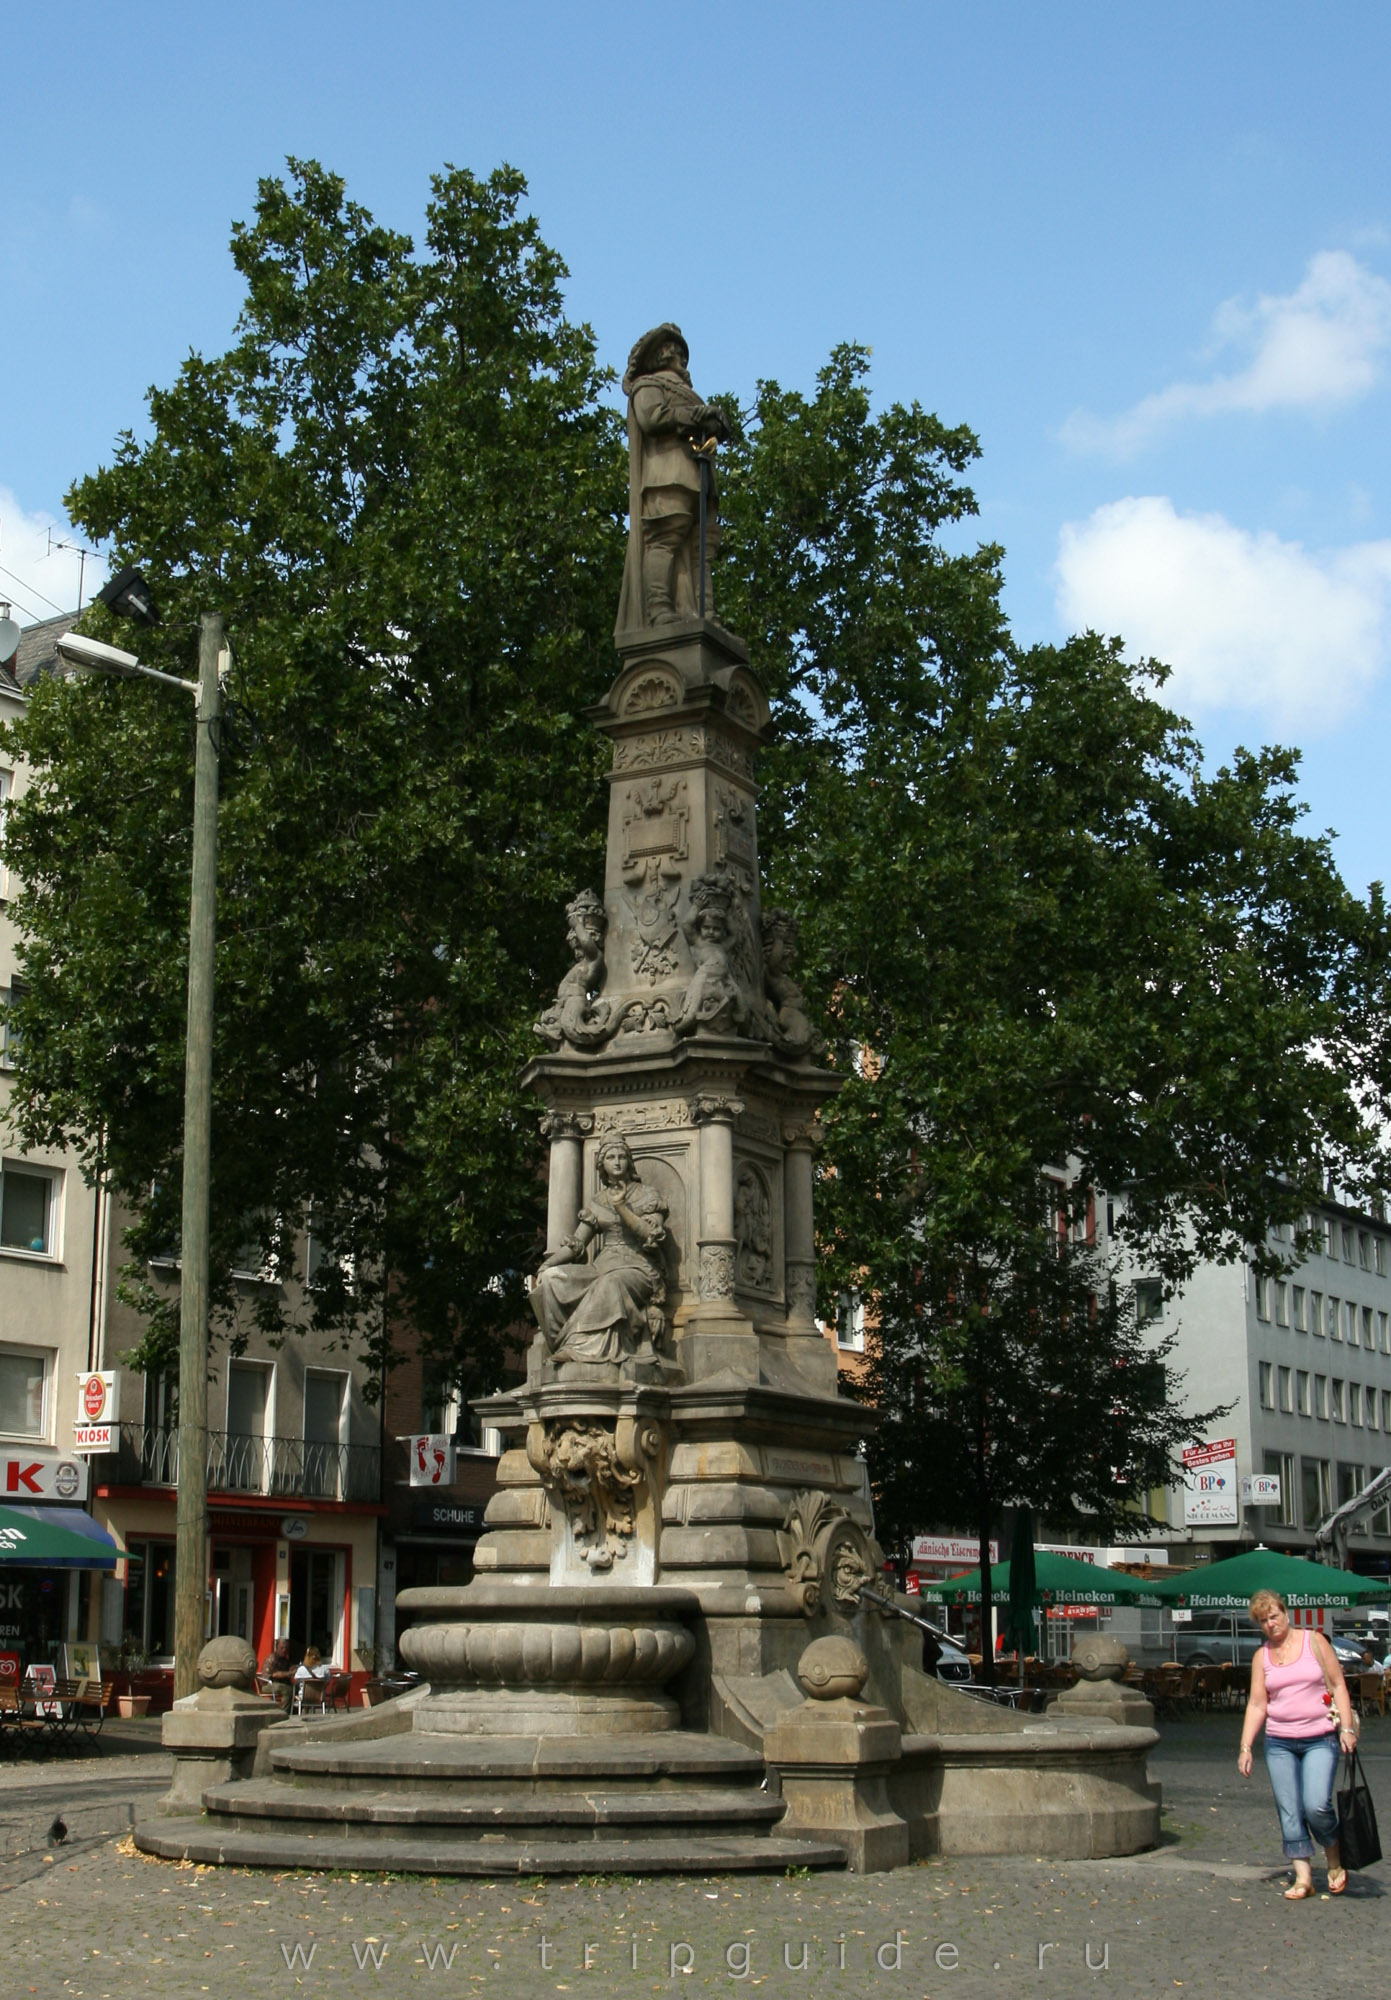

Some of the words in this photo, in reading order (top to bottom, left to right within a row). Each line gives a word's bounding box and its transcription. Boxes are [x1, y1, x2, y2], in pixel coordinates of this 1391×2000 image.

[77, 1428, 109, 1443] KIOSK
[1187, 1457, 1209, 1467] Bestes
[1210, 1452, 1231, 1462] geben
[433, 1508, 474, 1523] SCHUHE
[1056, 1590, 1115, 1603] Heineken
[1190, 1594, 1250, 1606] Heineken
[1287, 1593, 1349, 1606] Heineken
